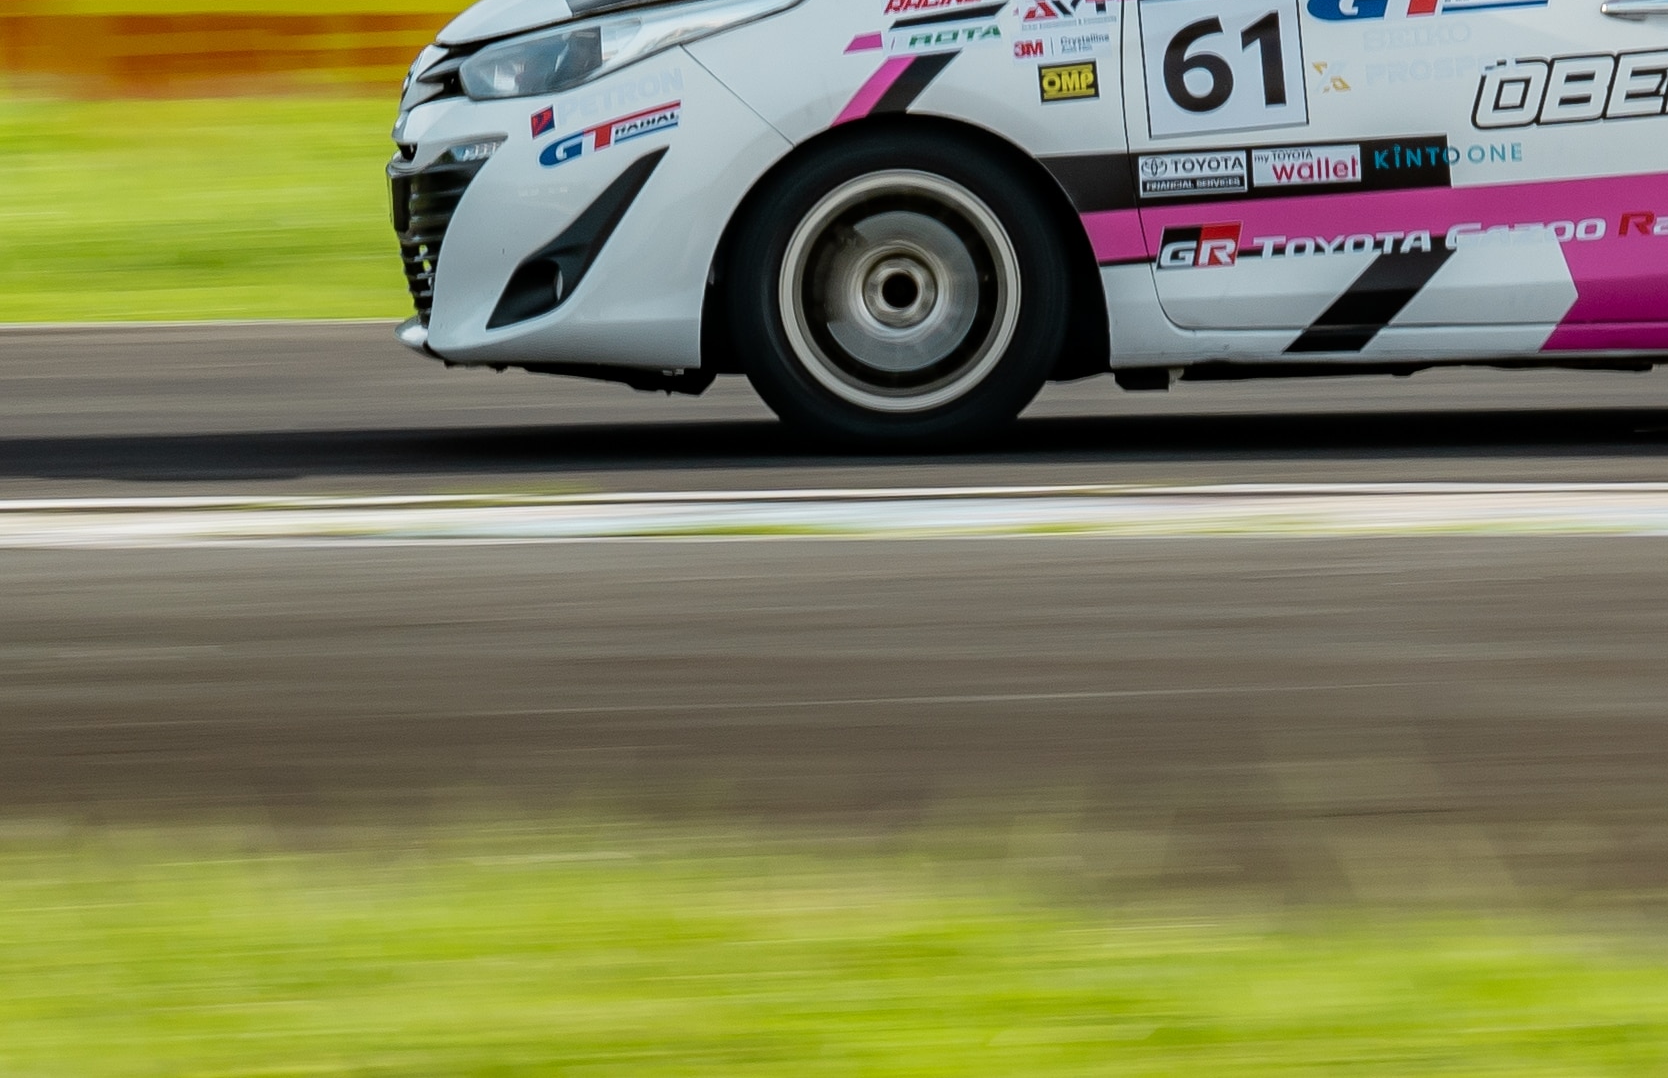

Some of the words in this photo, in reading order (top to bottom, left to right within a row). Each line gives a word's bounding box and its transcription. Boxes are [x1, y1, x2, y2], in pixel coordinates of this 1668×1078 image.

[1014, 39, 1044, 59] 3M
[1162, 10, 1287, 114] 61
[1042, 68, 1095, 96] OMP
[556, 68, 685, 125] PETRON
[1171, 156, 1244, 174] TOYOTA
[1254, 153, 1270, 164] my
[1271, 148, 1314, 161] TOYOTA
[1467, 141, 1523, 164] ONE
[1272, 154, 1358, 184] wallet
[1158, 239, 1238, 268] GR
[1254, 231, 1433, 260] TOYOTA
